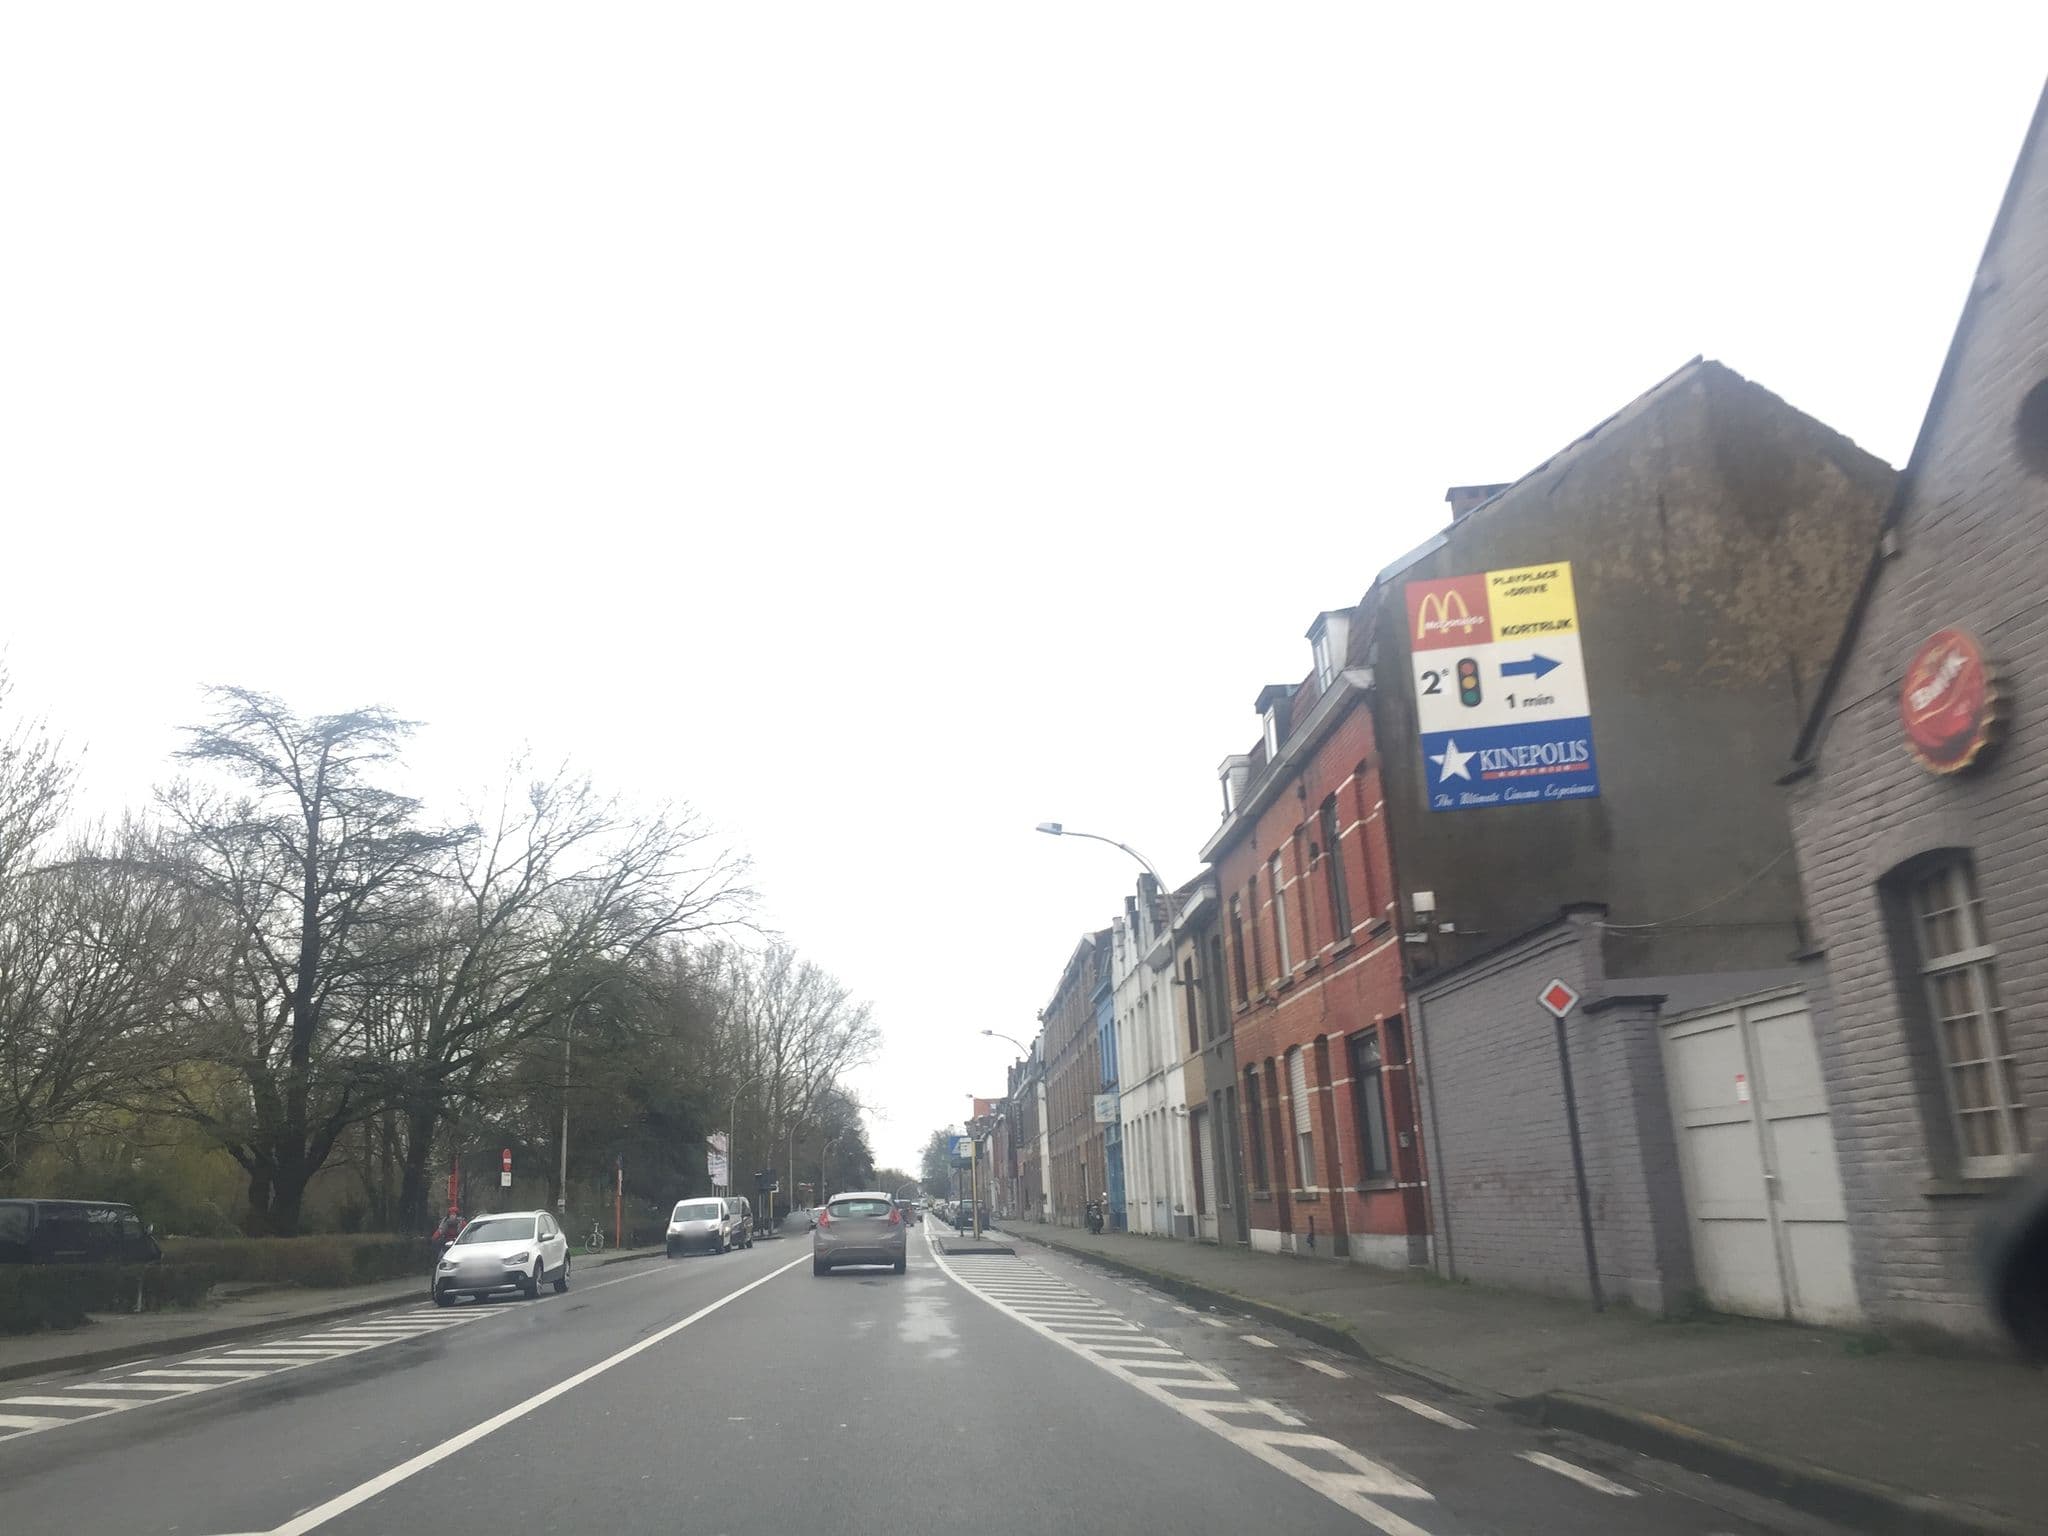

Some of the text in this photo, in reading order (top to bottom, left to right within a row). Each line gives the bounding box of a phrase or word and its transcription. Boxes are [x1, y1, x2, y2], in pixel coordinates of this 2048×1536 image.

[1501, 618, 1573, 636] KORTRIJK
[1505, 693, 1555, 709] 1 min
[1479, 740, 1589, 771] KINEPOLIS
